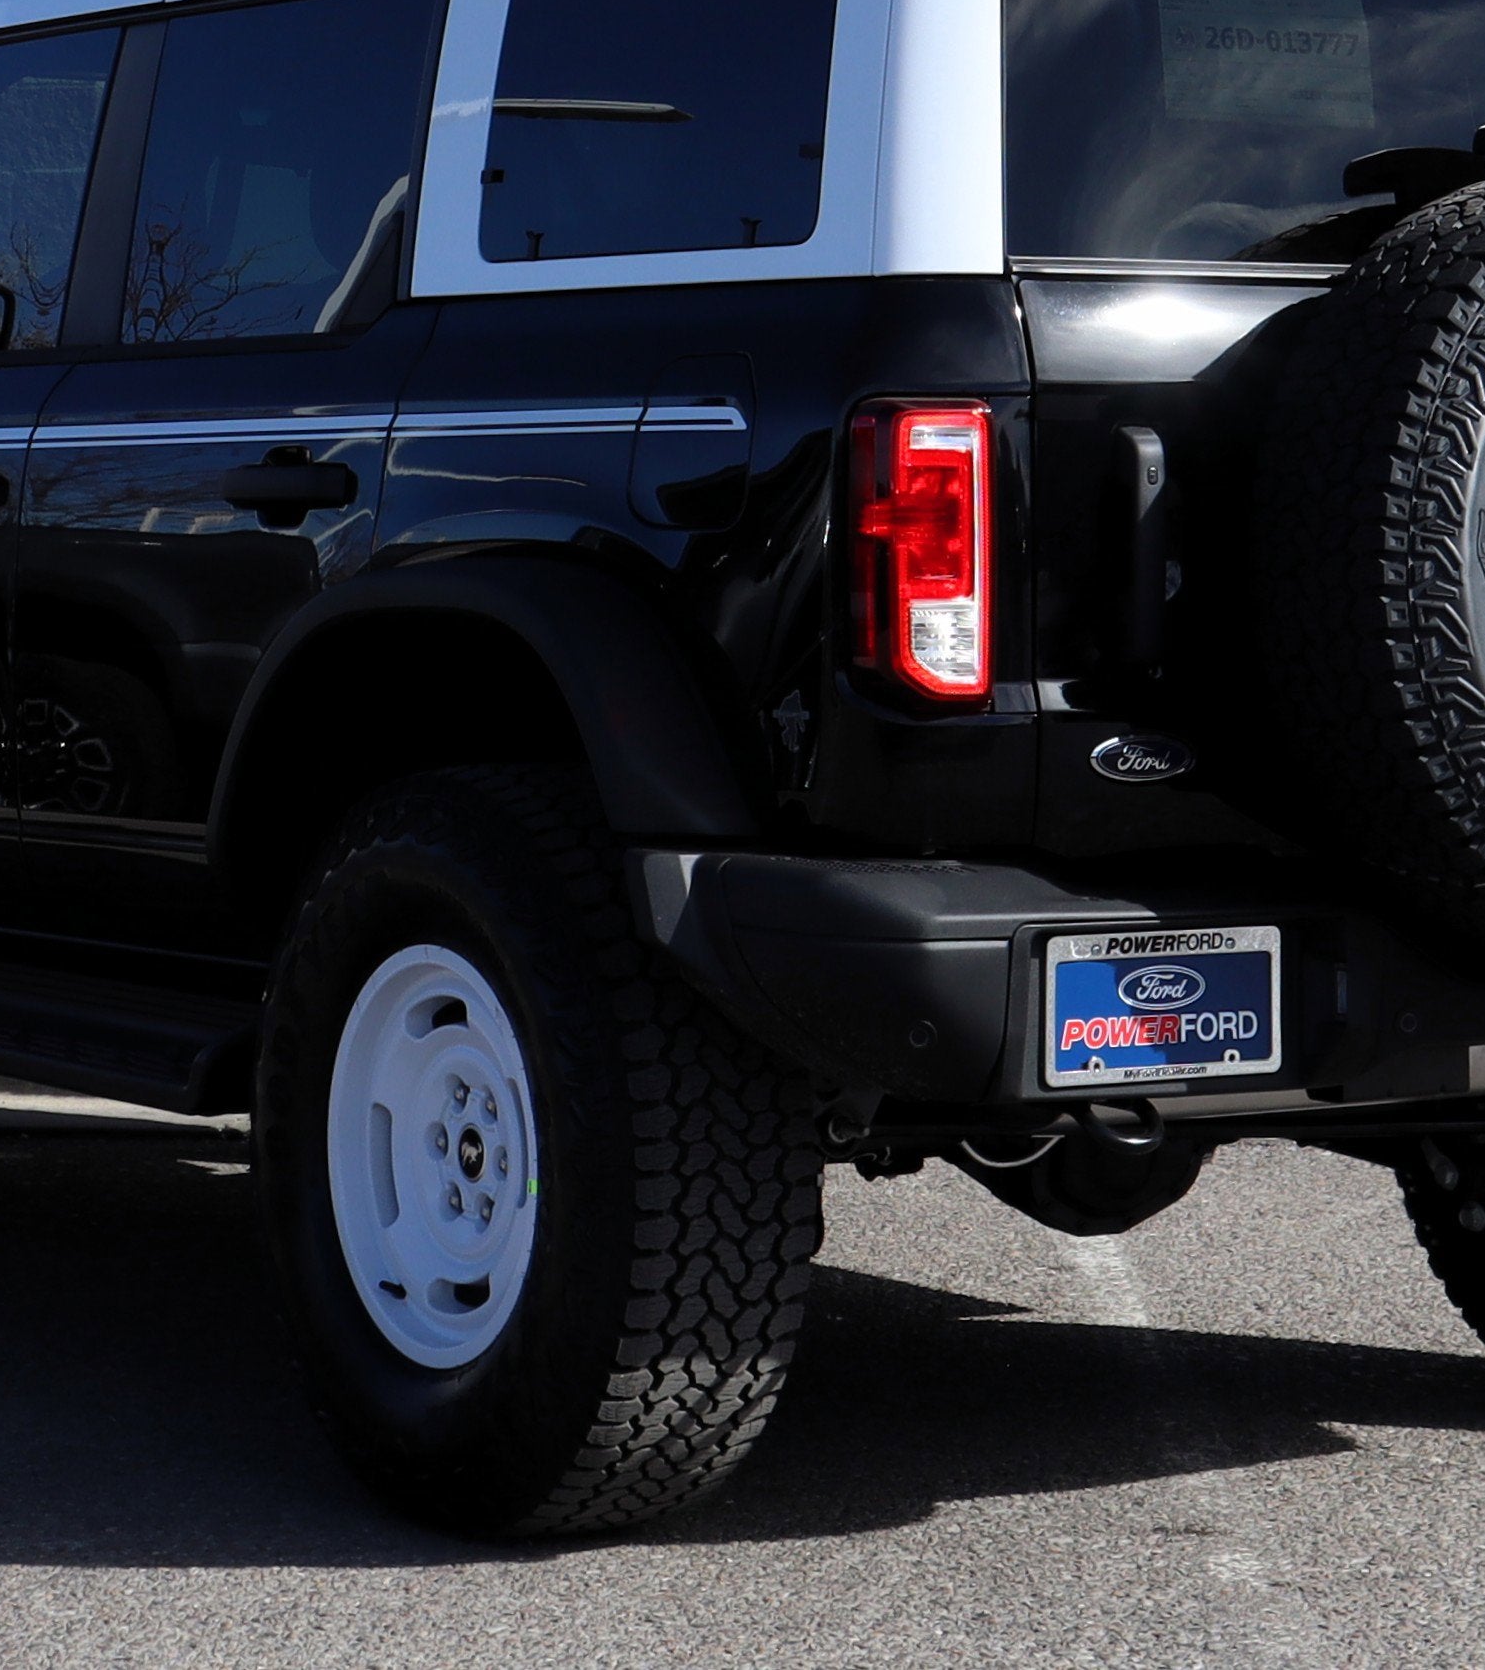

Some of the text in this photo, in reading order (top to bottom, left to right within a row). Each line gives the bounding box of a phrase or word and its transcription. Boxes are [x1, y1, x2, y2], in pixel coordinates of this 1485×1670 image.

[1203, 26, 1360, 57] 26D-013777
[1117, 744, 1171, 771] Ford
[1105, 932, 1225, 955] POWERFORD
[1135, 973, 1187, 1000] Ford
[1060, 1010, 1258, 1051] POWERFORD
